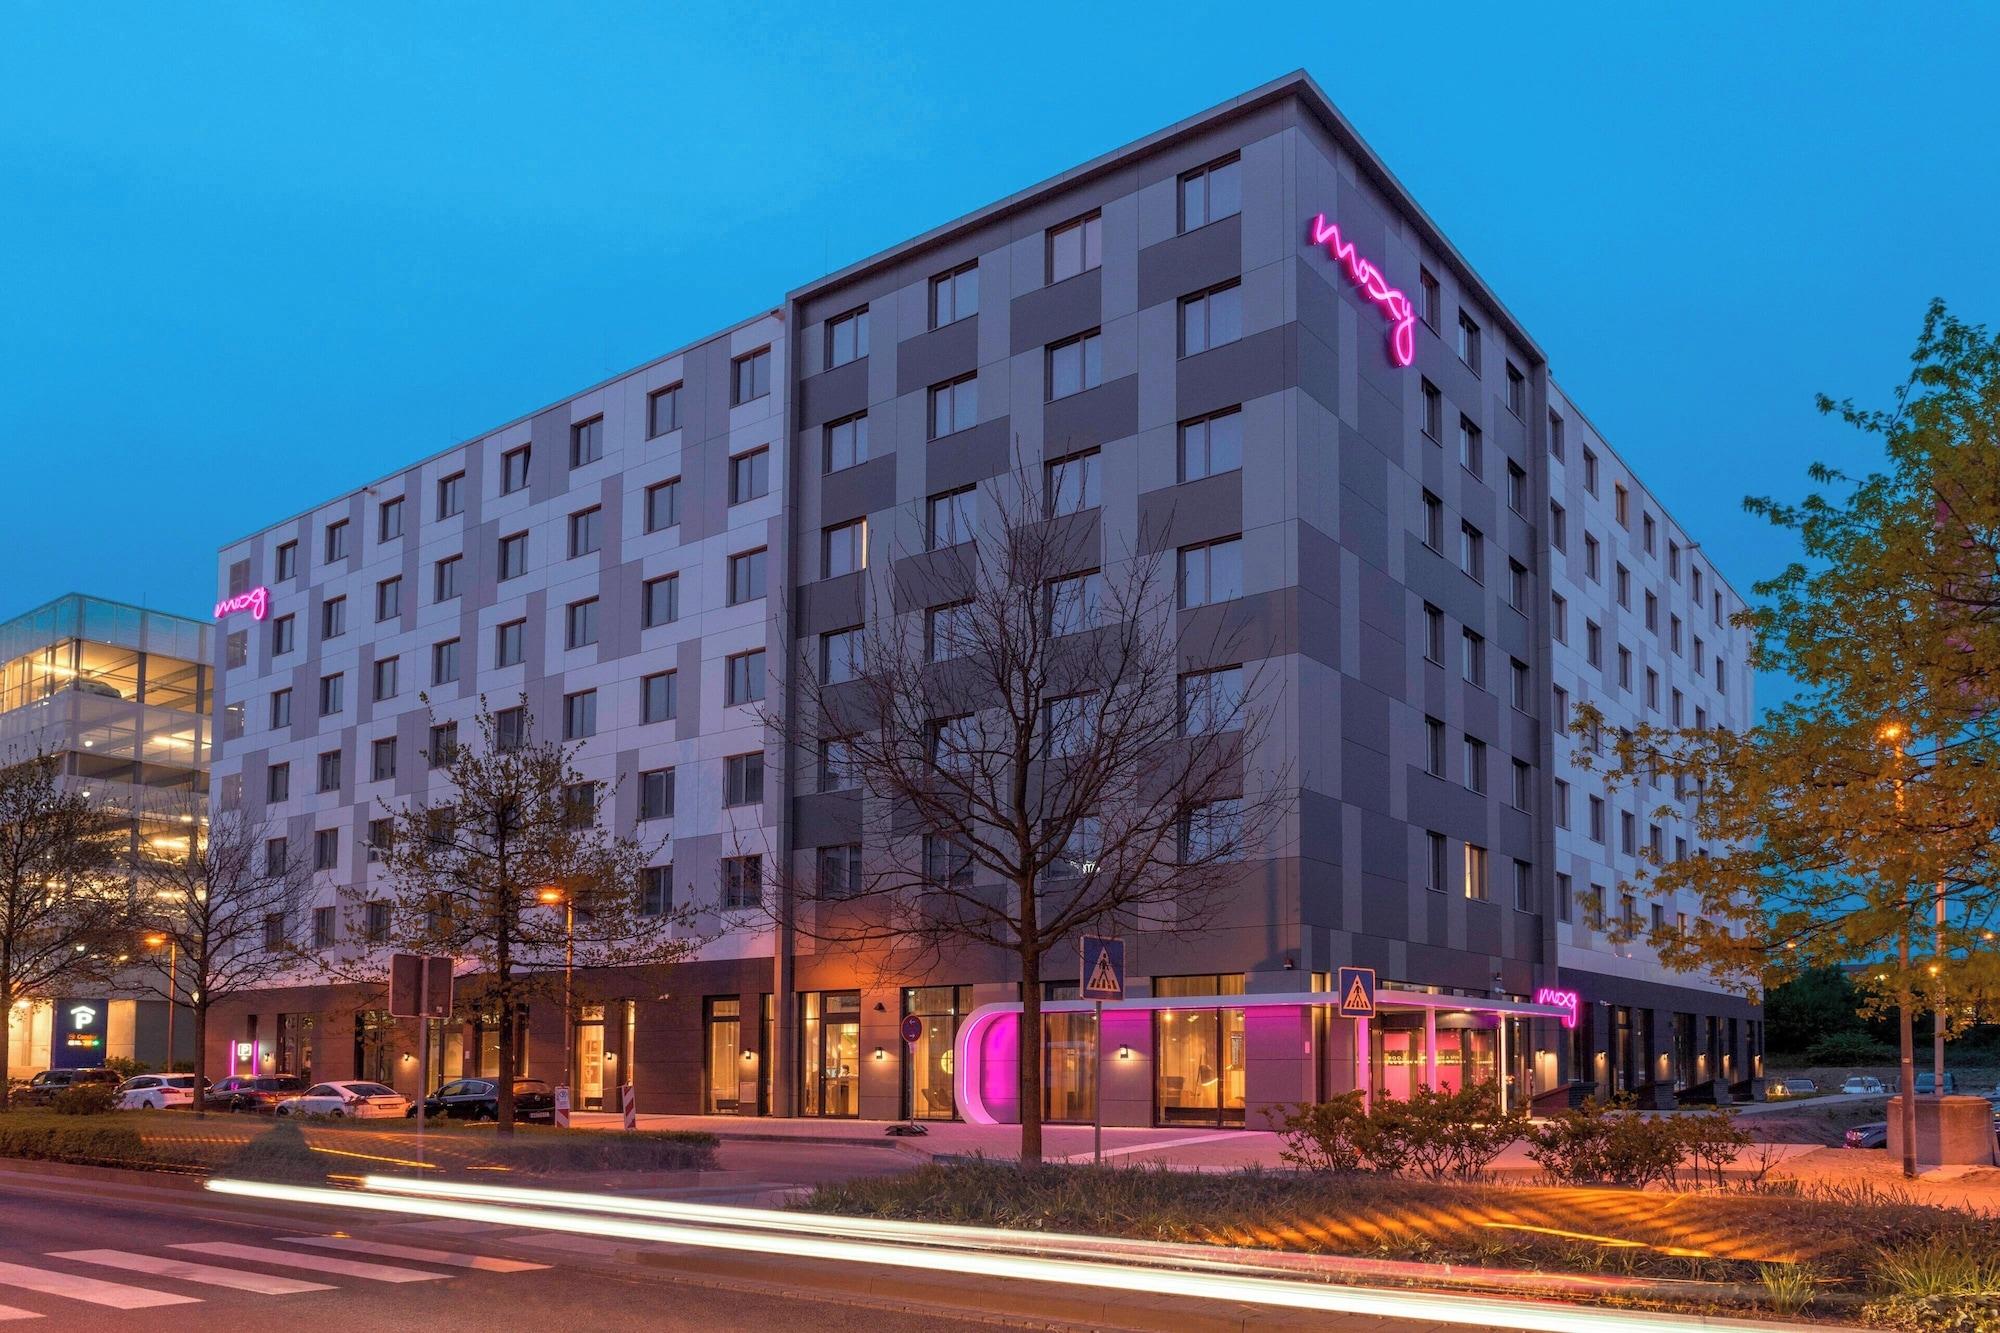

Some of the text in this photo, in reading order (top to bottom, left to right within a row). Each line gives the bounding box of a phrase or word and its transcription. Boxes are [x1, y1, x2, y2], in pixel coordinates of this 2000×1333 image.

[1315, 212, 1415, 367] moxy
[215, 586, 267, 620] moxy
[75, 1012, 93, 1030] P
[1538, 987, 1577, 1028] moxy
